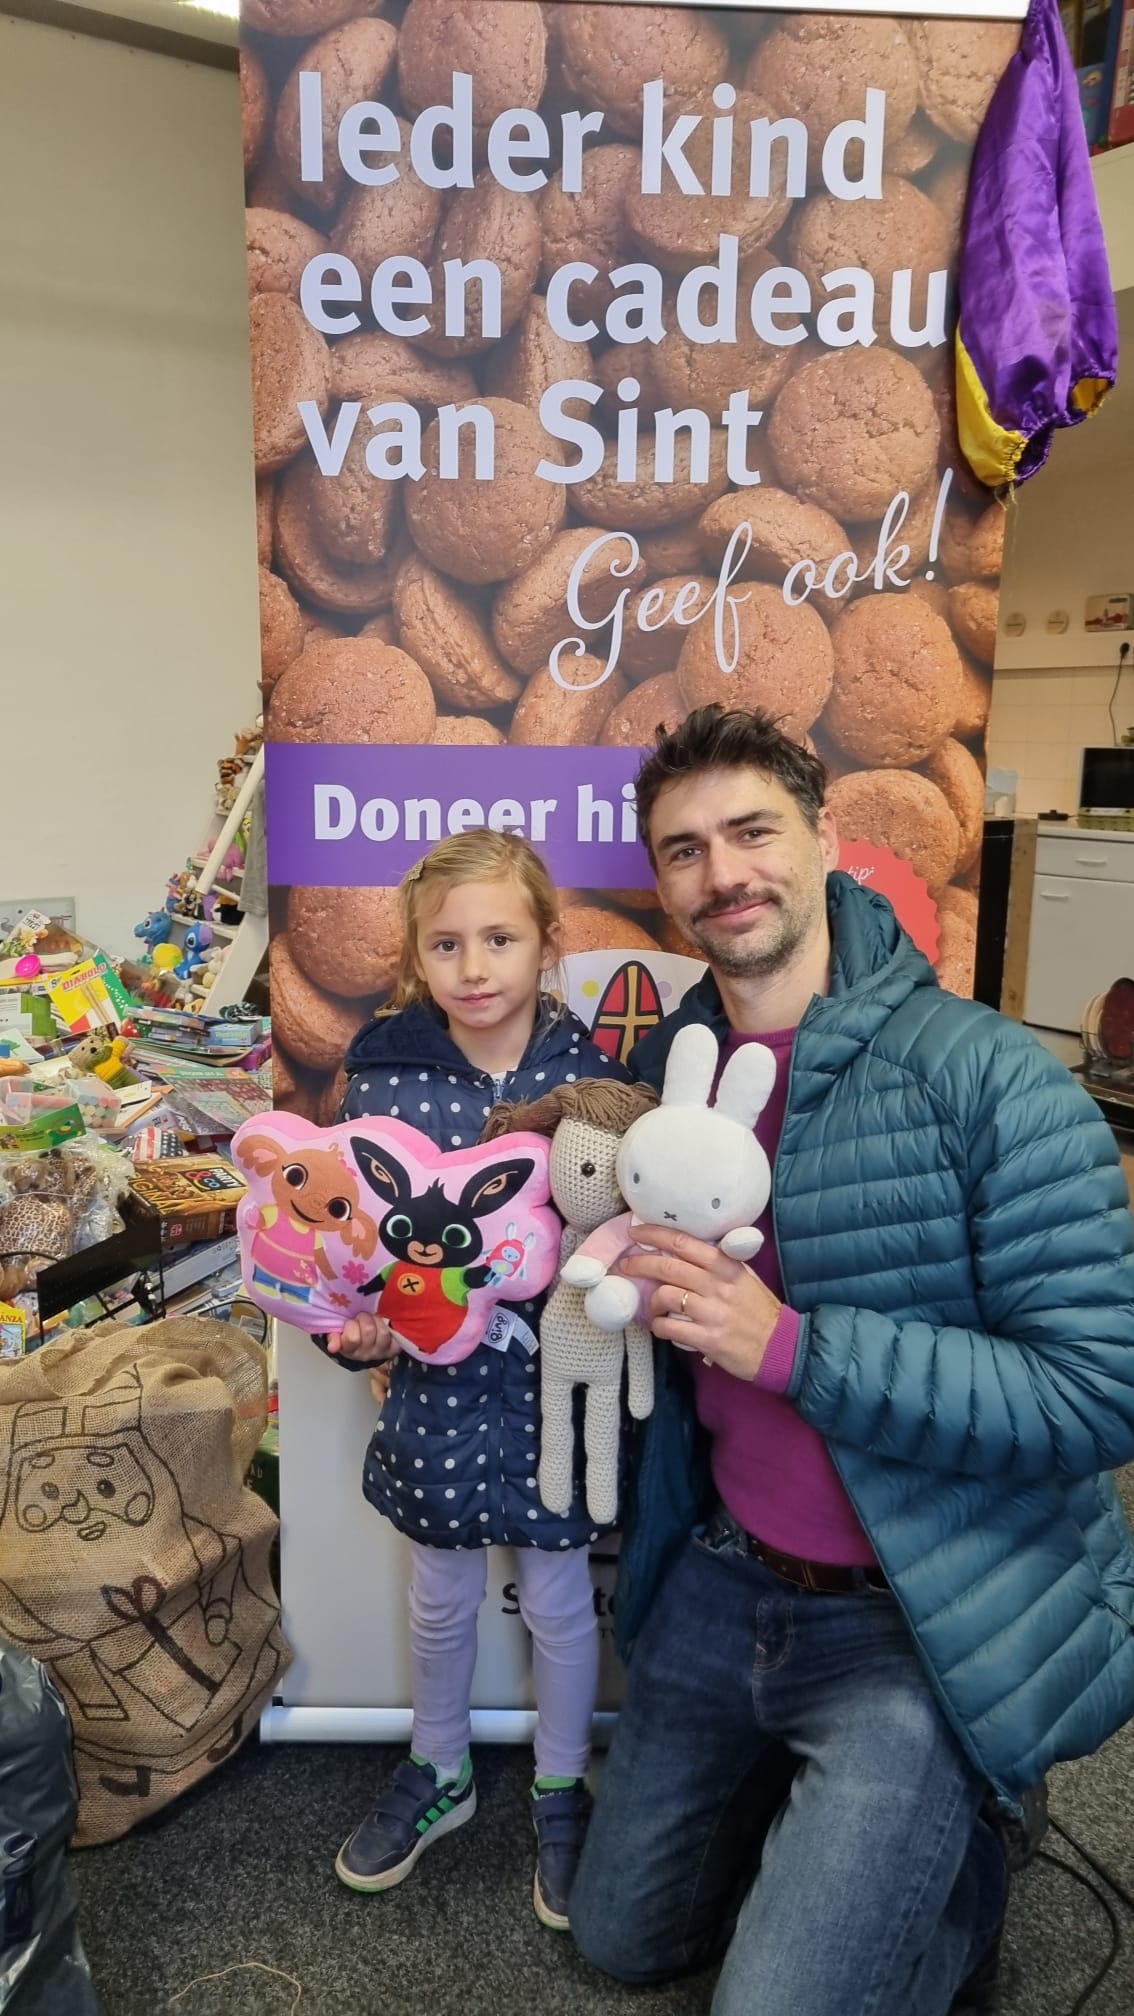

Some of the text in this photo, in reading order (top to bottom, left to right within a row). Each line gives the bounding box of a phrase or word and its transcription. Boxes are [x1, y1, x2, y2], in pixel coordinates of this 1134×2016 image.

[298, 71, 884, 200] Ieder kind
[299, 235, 948, 348] een cadeau
[298, 378, 764, 486] van Sint
[549, 469, 954, 691] Geef ook!
[313, 783, 557, 842] Doneer
[62, 963, 106, 991] DIABOLO
[209, 1167, 241, 1187] PARTY
[490, 1315, 508, 1342] Bing
